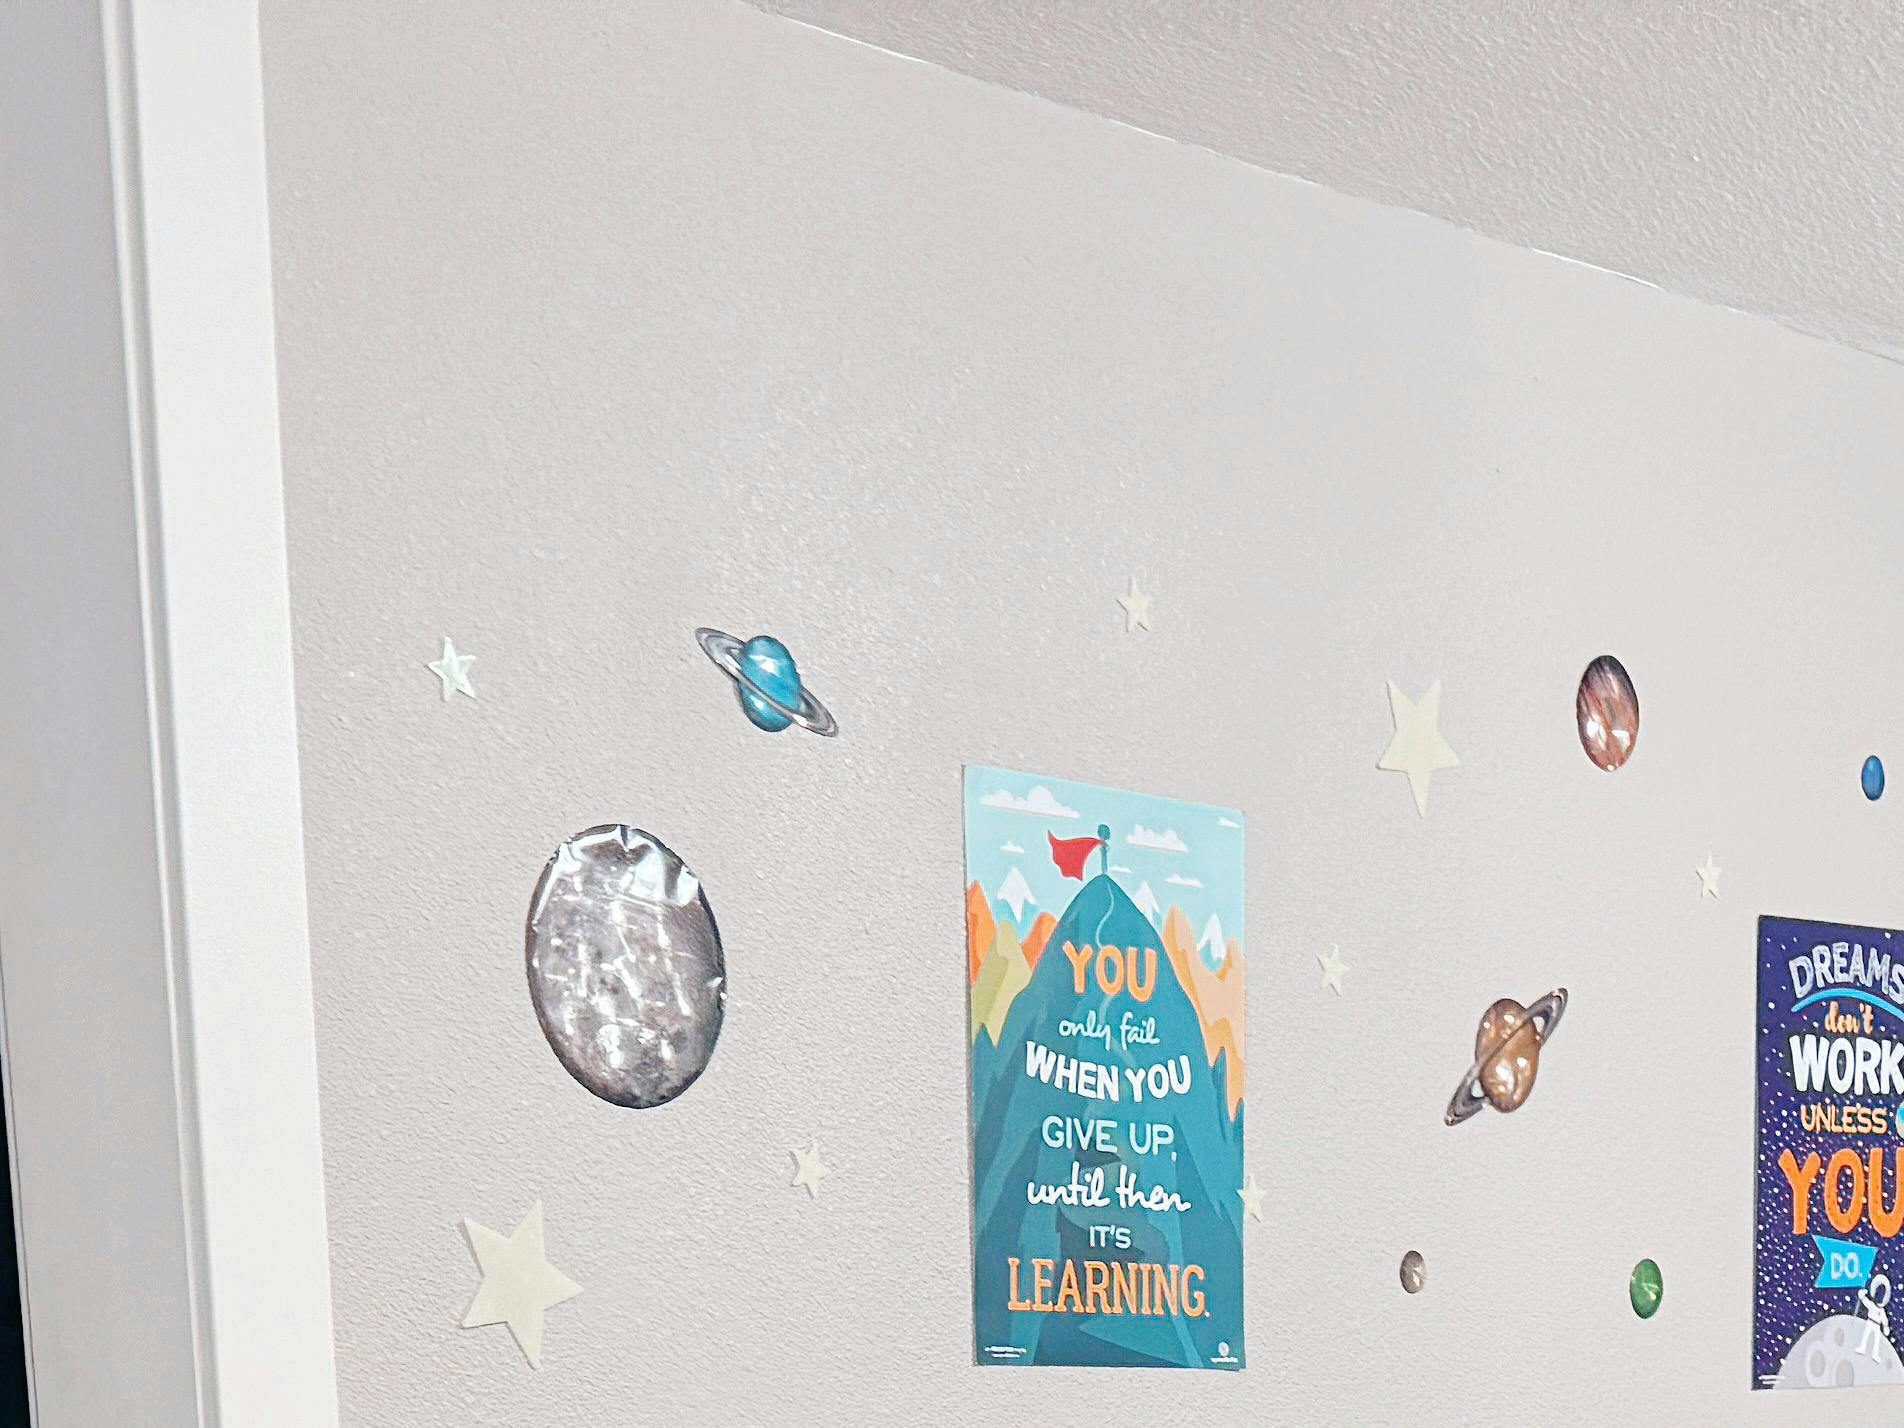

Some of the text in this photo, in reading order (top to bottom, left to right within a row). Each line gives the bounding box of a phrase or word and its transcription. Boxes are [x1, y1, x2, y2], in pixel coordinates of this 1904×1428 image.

[1062, 939, 1157, 1003] YOU
[1058, 1011, 1160, 1051] only fail
[1824, 1000, 1875, 1034] don't
[1025, 1040, 1193, 1103] WHEN YOU
[1041, 1115, 1119, 1155] GIVE
[1800, 1102, 1889, 1136] UNLESS
[1026, 1161, 1191, 1213] until then
[1088, 1224, 1132, 1250] IT'S
[1829, 1250, 1864, 1280] DO.
[1007, 1256, 1211, 1319] LEARNING.
